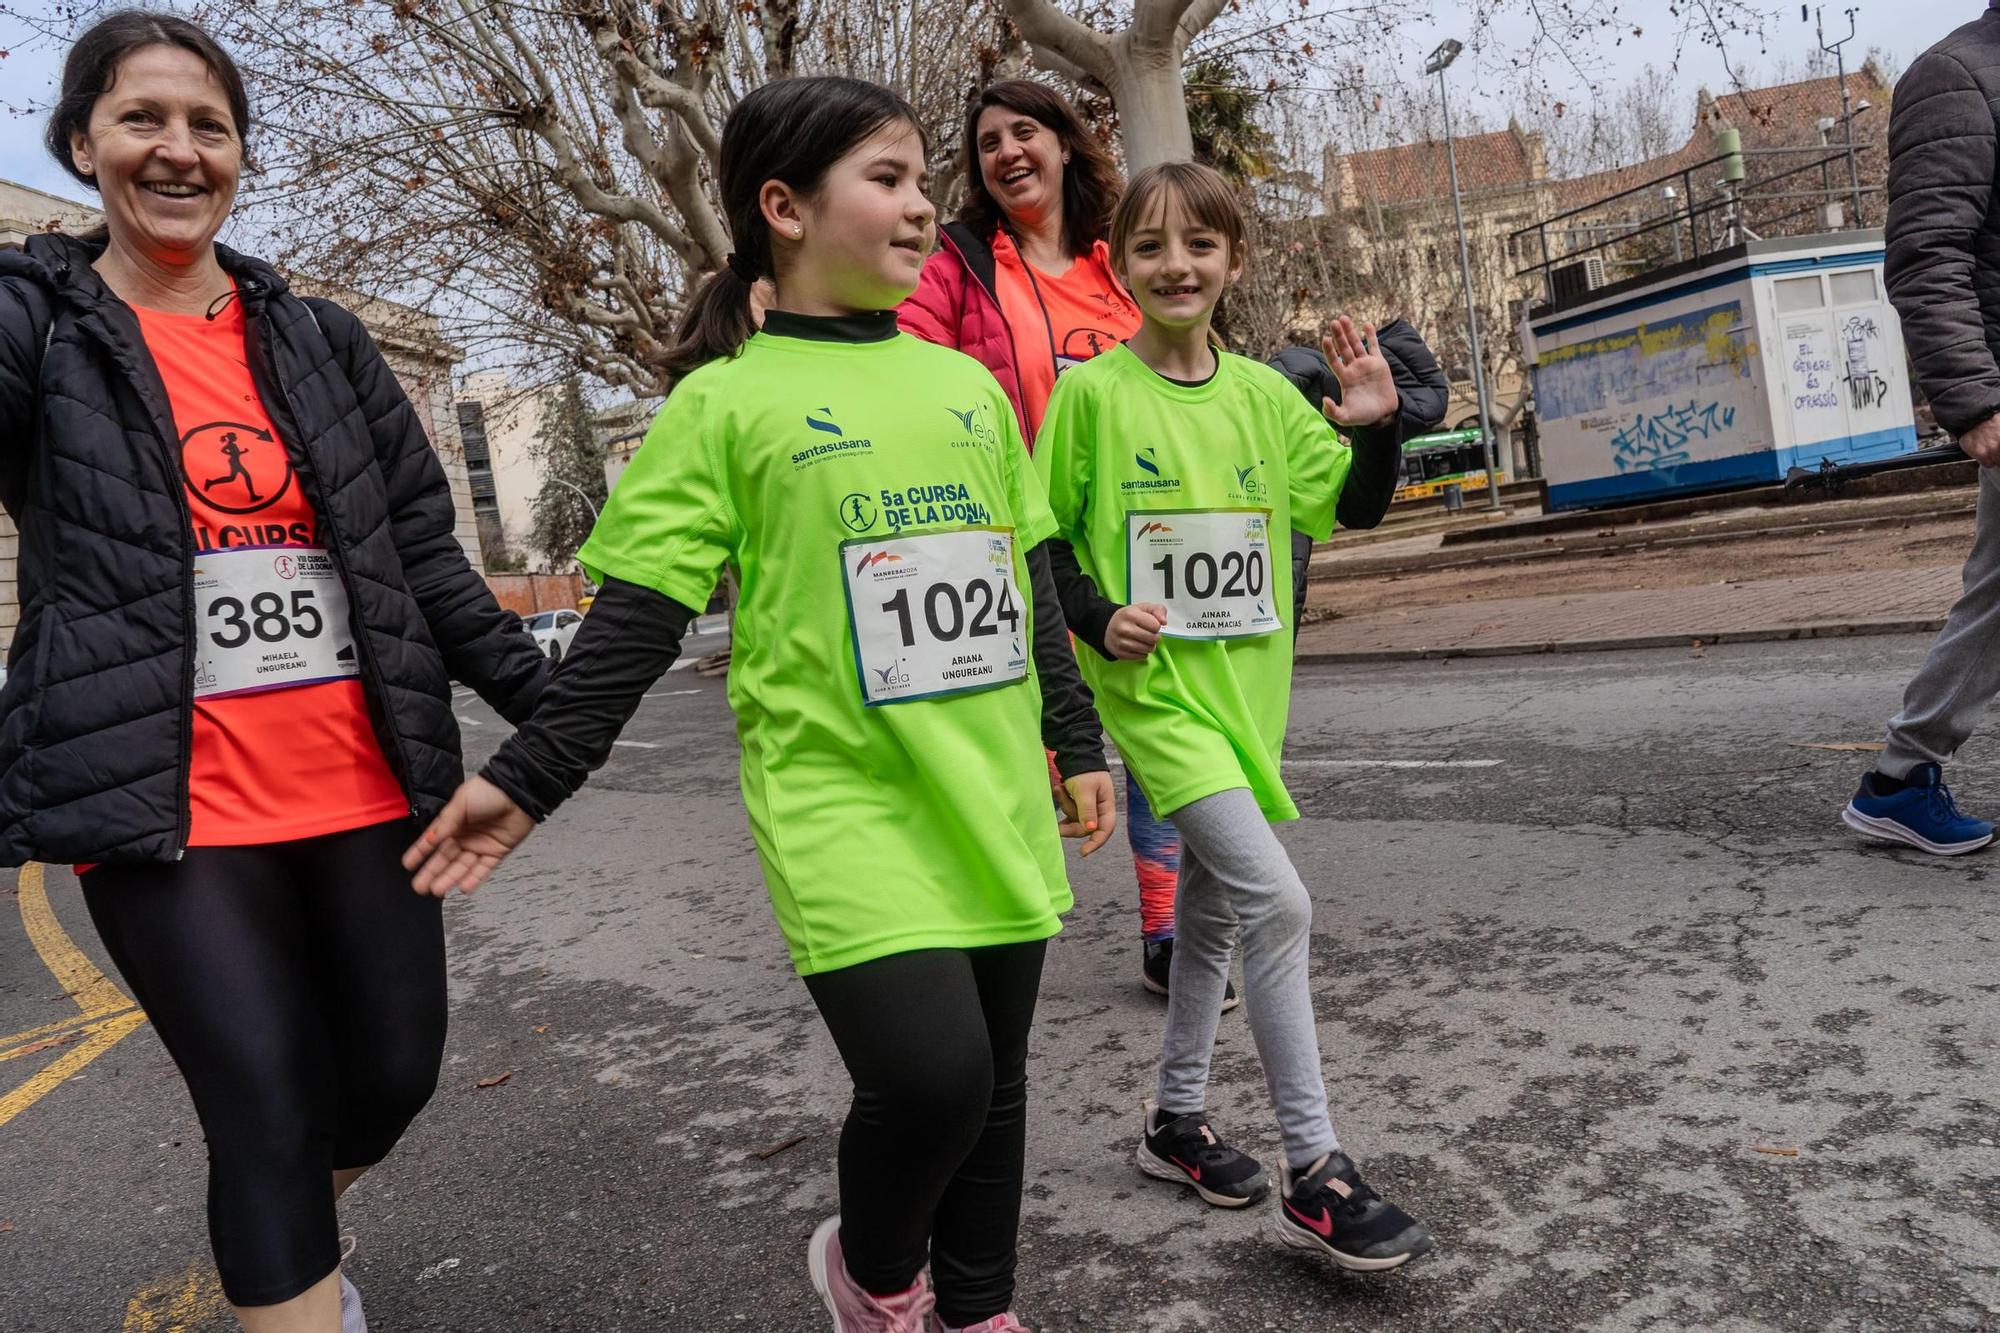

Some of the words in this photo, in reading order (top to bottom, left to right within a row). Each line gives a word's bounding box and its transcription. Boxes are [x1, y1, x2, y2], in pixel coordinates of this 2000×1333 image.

[791, 439, 872, 464] santasusana
[1120, 479, 1180, 490] santasusana
[880, 490, 905, 507] 5a
[907, 484, 970, 505] CURSA
[885, 507, 912, 527] DE
[914, 505, 940, 524] LA
[941, 502, 987, 521] DONA
[1153, 550, 1263, 600] 1020
[207, 590, 323, 648] 385
[882, 578, 1019, 647] 1024
[1186, 621, 1216, 629] GARCIA
[1217, 620, 1242, 629] MACIAS
[262, 651, 299, 662] MIHAELA
[952, 654, 983, 666] ARIANA
[257, 661, 307, 674] UNGUREANU
[942, 665, 993, 681] UNGUREANU
